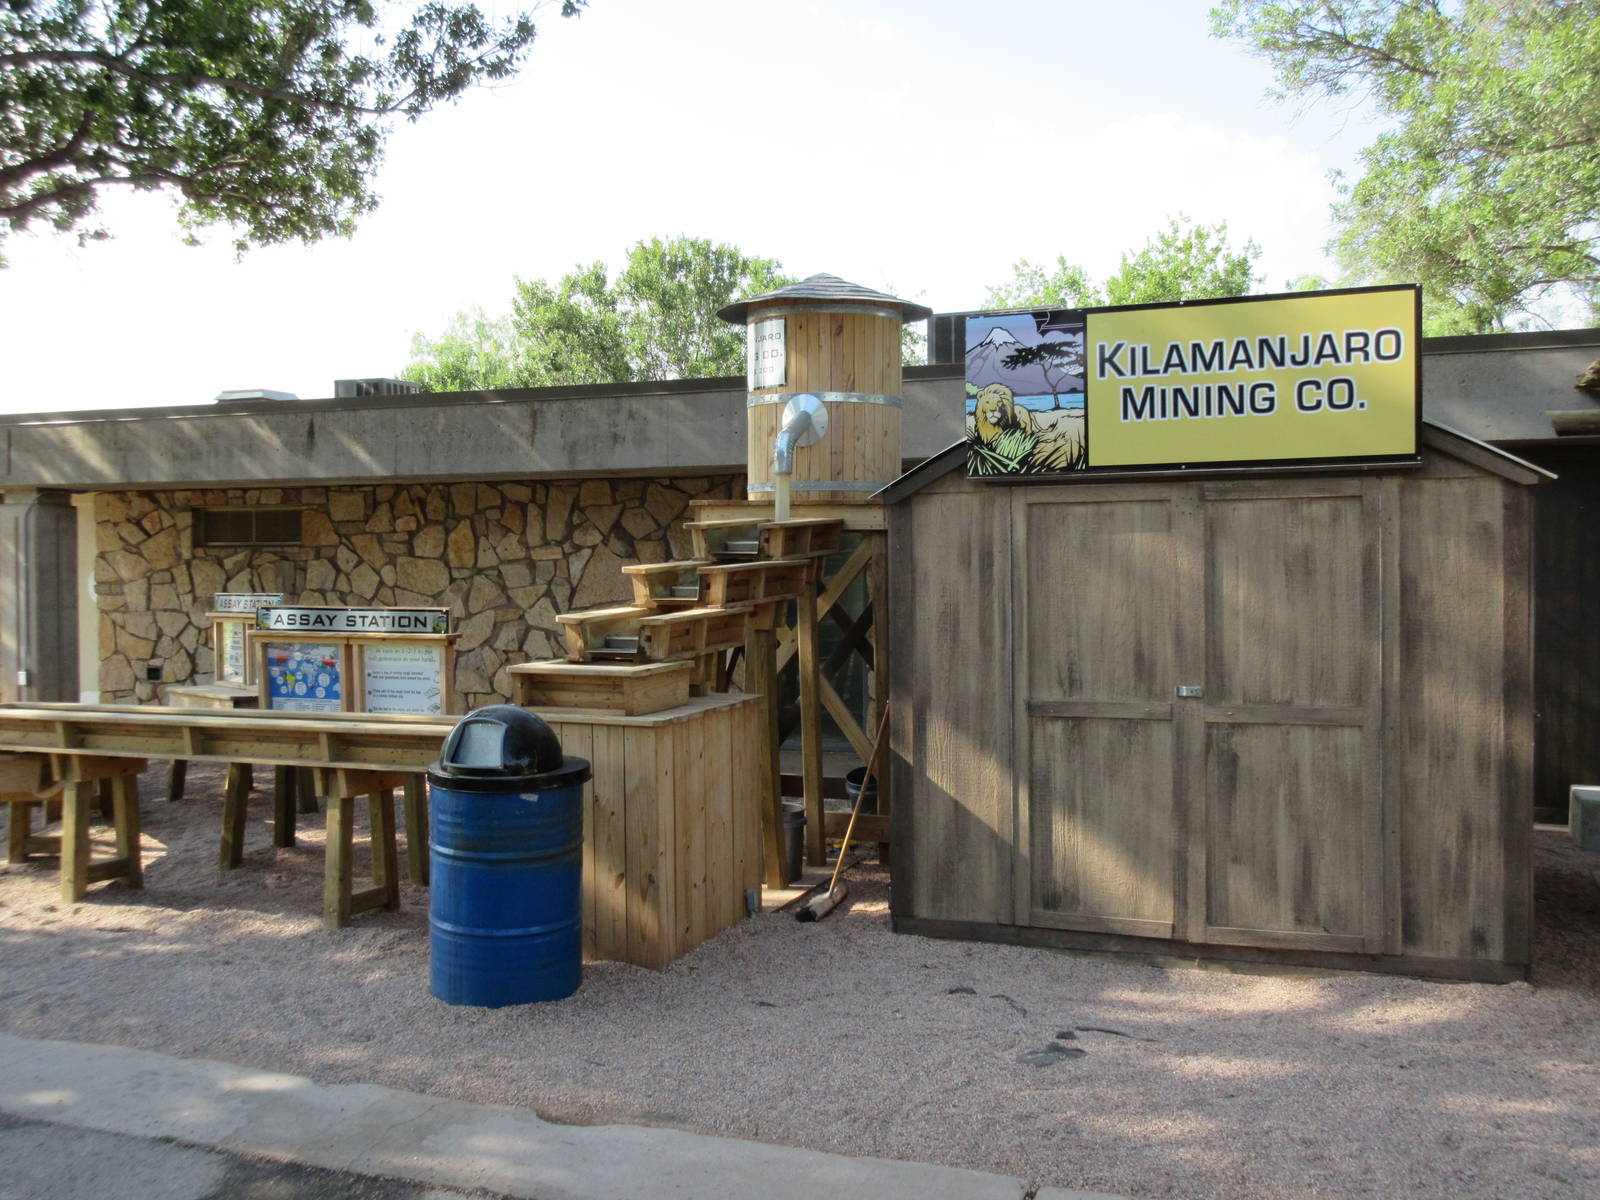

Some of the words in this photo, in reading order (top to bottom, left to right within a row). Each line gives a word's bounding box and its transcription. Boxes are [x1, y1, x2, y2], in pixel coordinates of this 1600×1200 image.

[1097, 328, 1403, 379] KILAMANJARO
[1121, 381, 1276, 421] MINING
[1296, 376, 1367, 412] CO.
[219, 599, 241, 609] ASSAY
[273, 613, 338, 627] ASSAY
[345, 614, 428, 628] STATION
